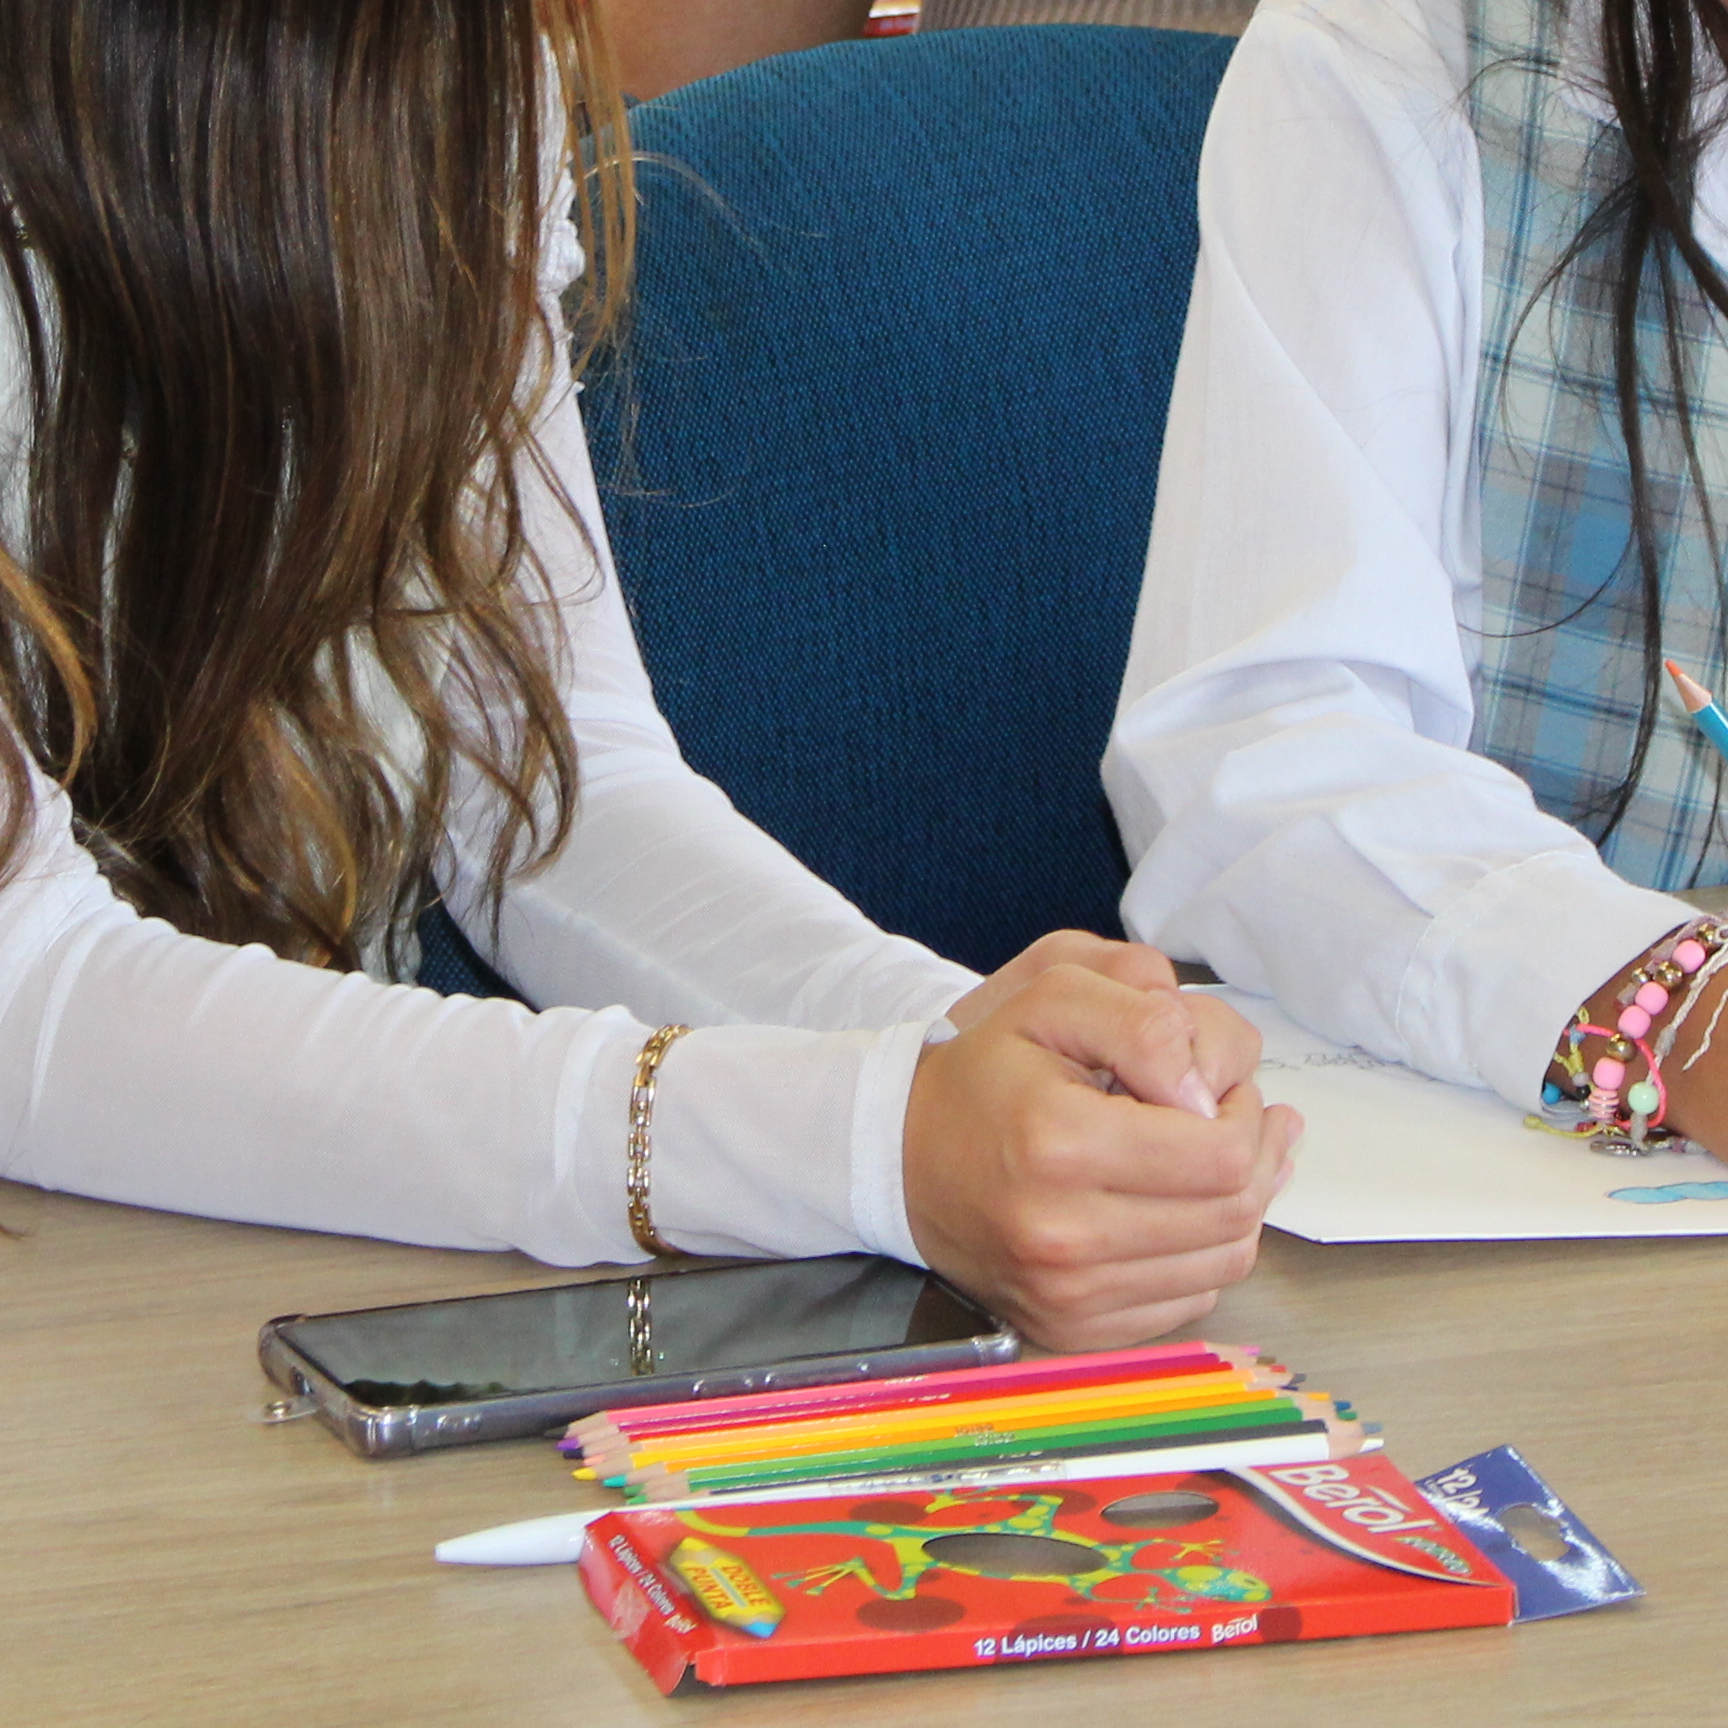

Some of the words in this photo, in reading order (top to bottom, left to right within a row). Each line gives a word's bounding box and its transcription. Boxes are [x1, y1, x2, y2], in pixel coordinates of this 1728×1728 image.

[1269, 1464, 1436, 1534] Berol
[974, 1637, 996, 1657] 12
[1001, 1632, 1077, 1658] Lápices
[1094, 1628, 1121, 1648] 24
[1125, 1624, 1201, 1645] Colores
[1211, 1613, 1260, 1643] Berol
